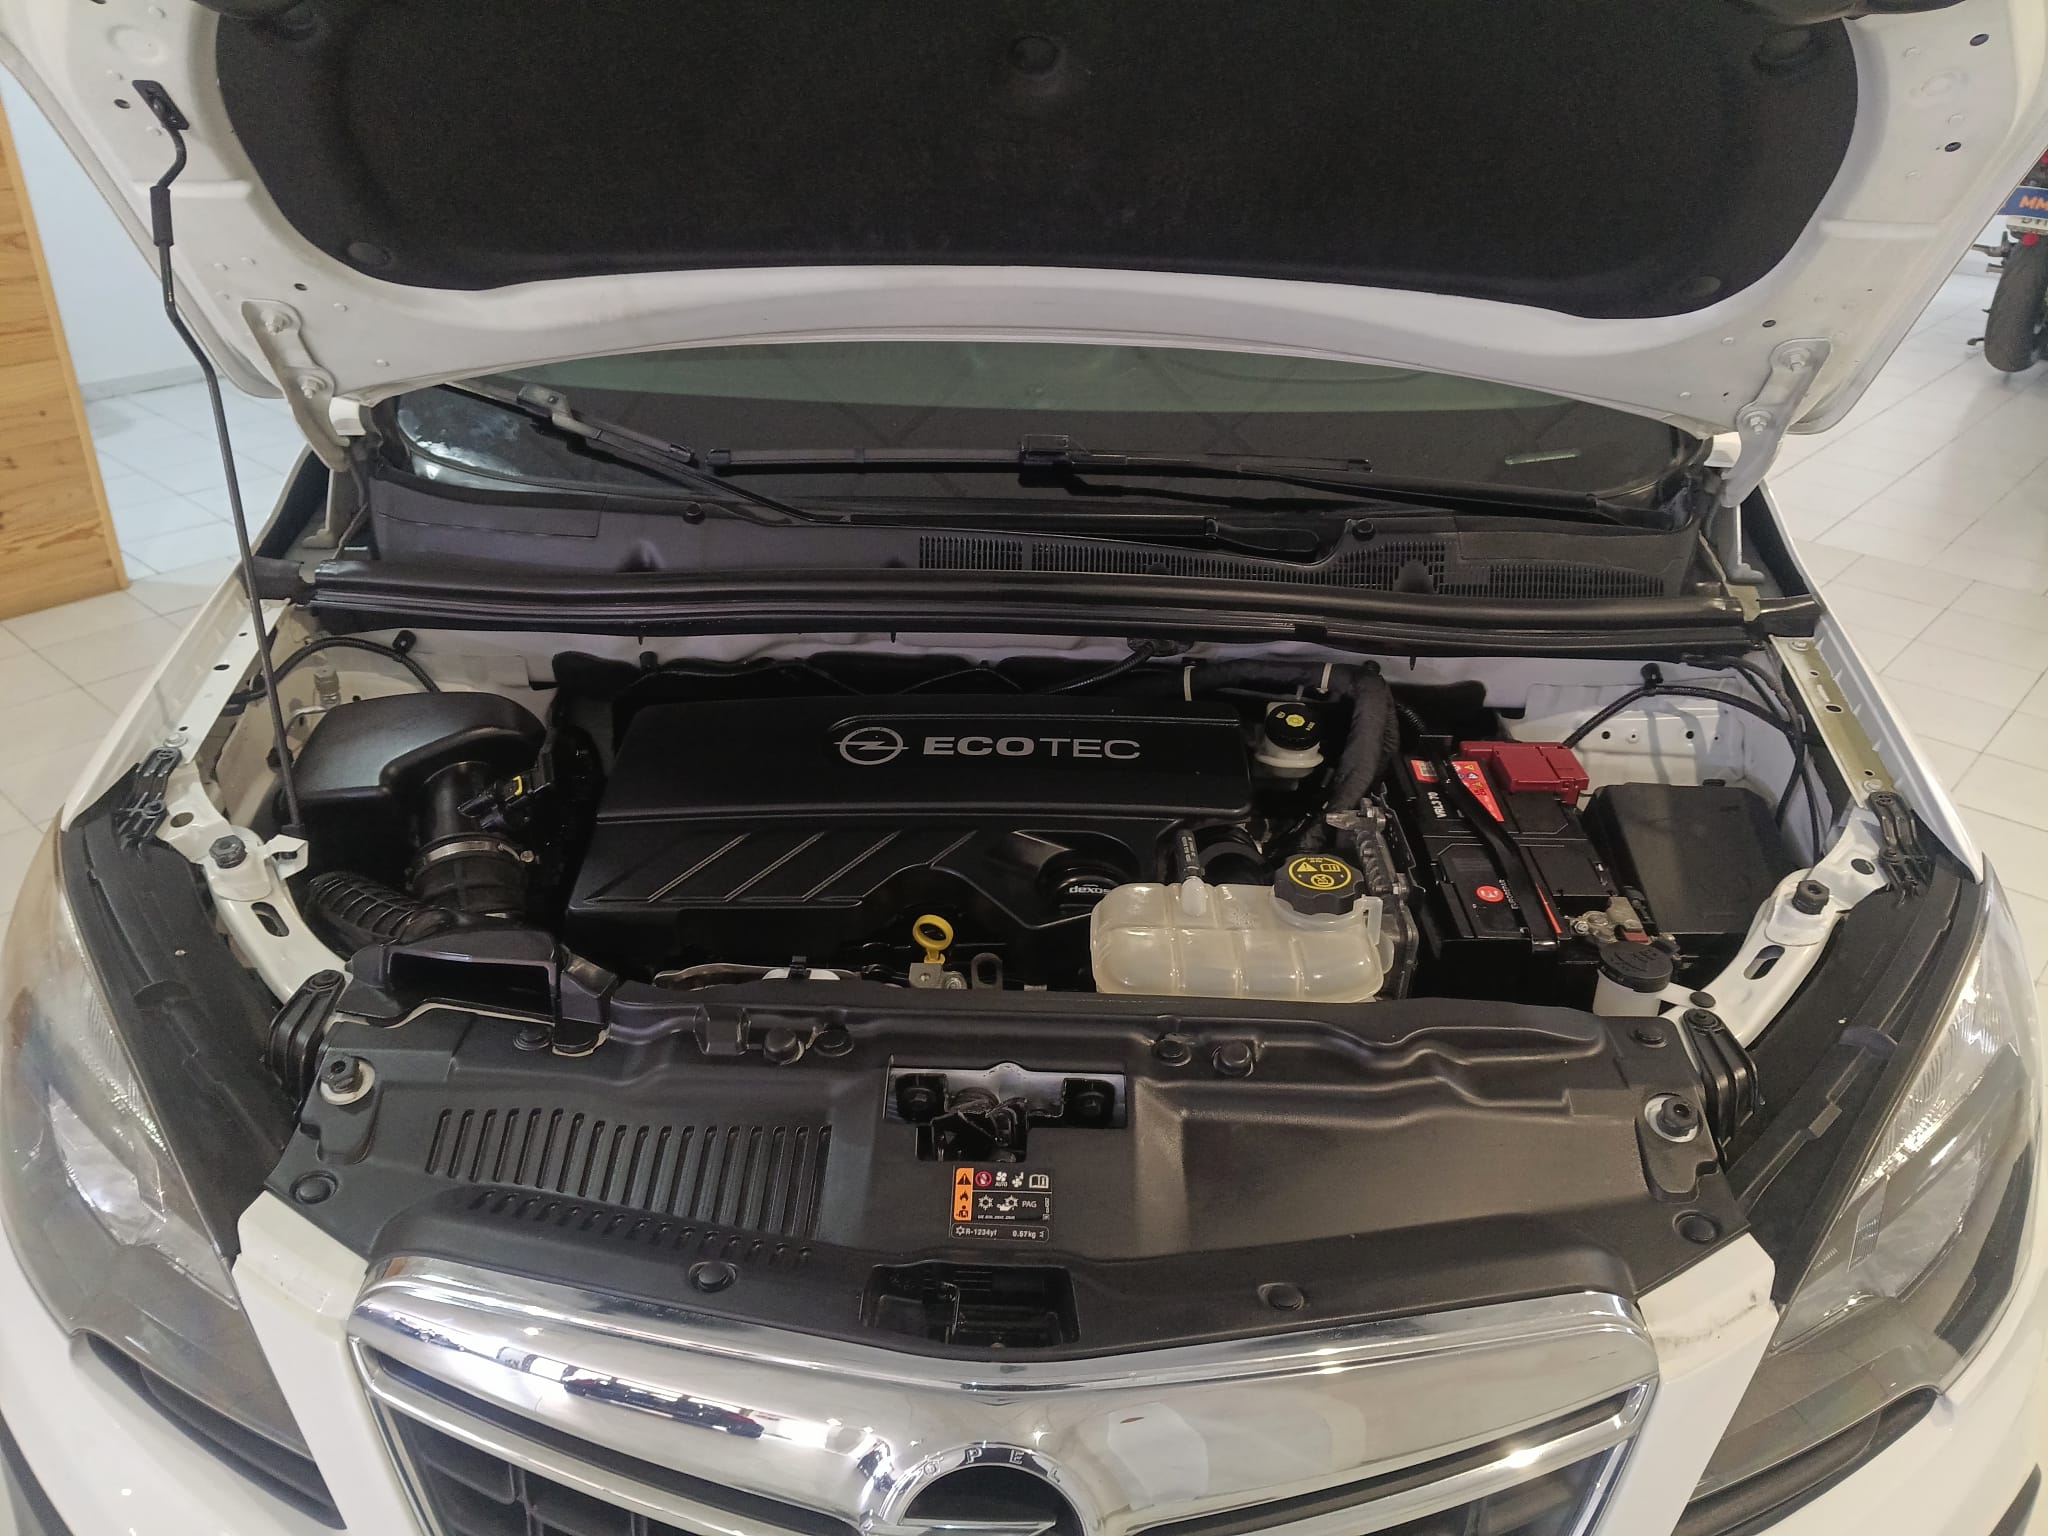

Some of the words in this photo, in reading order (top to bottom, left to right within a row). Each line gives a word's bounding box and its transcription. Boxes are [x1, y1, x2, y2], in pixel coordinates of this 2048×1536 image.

[923, 736, 1141, 760] ECOTEC
[1021, 1200, 1037, 1208] PAG
[923, 1447, 1061, 1484] OPEL
